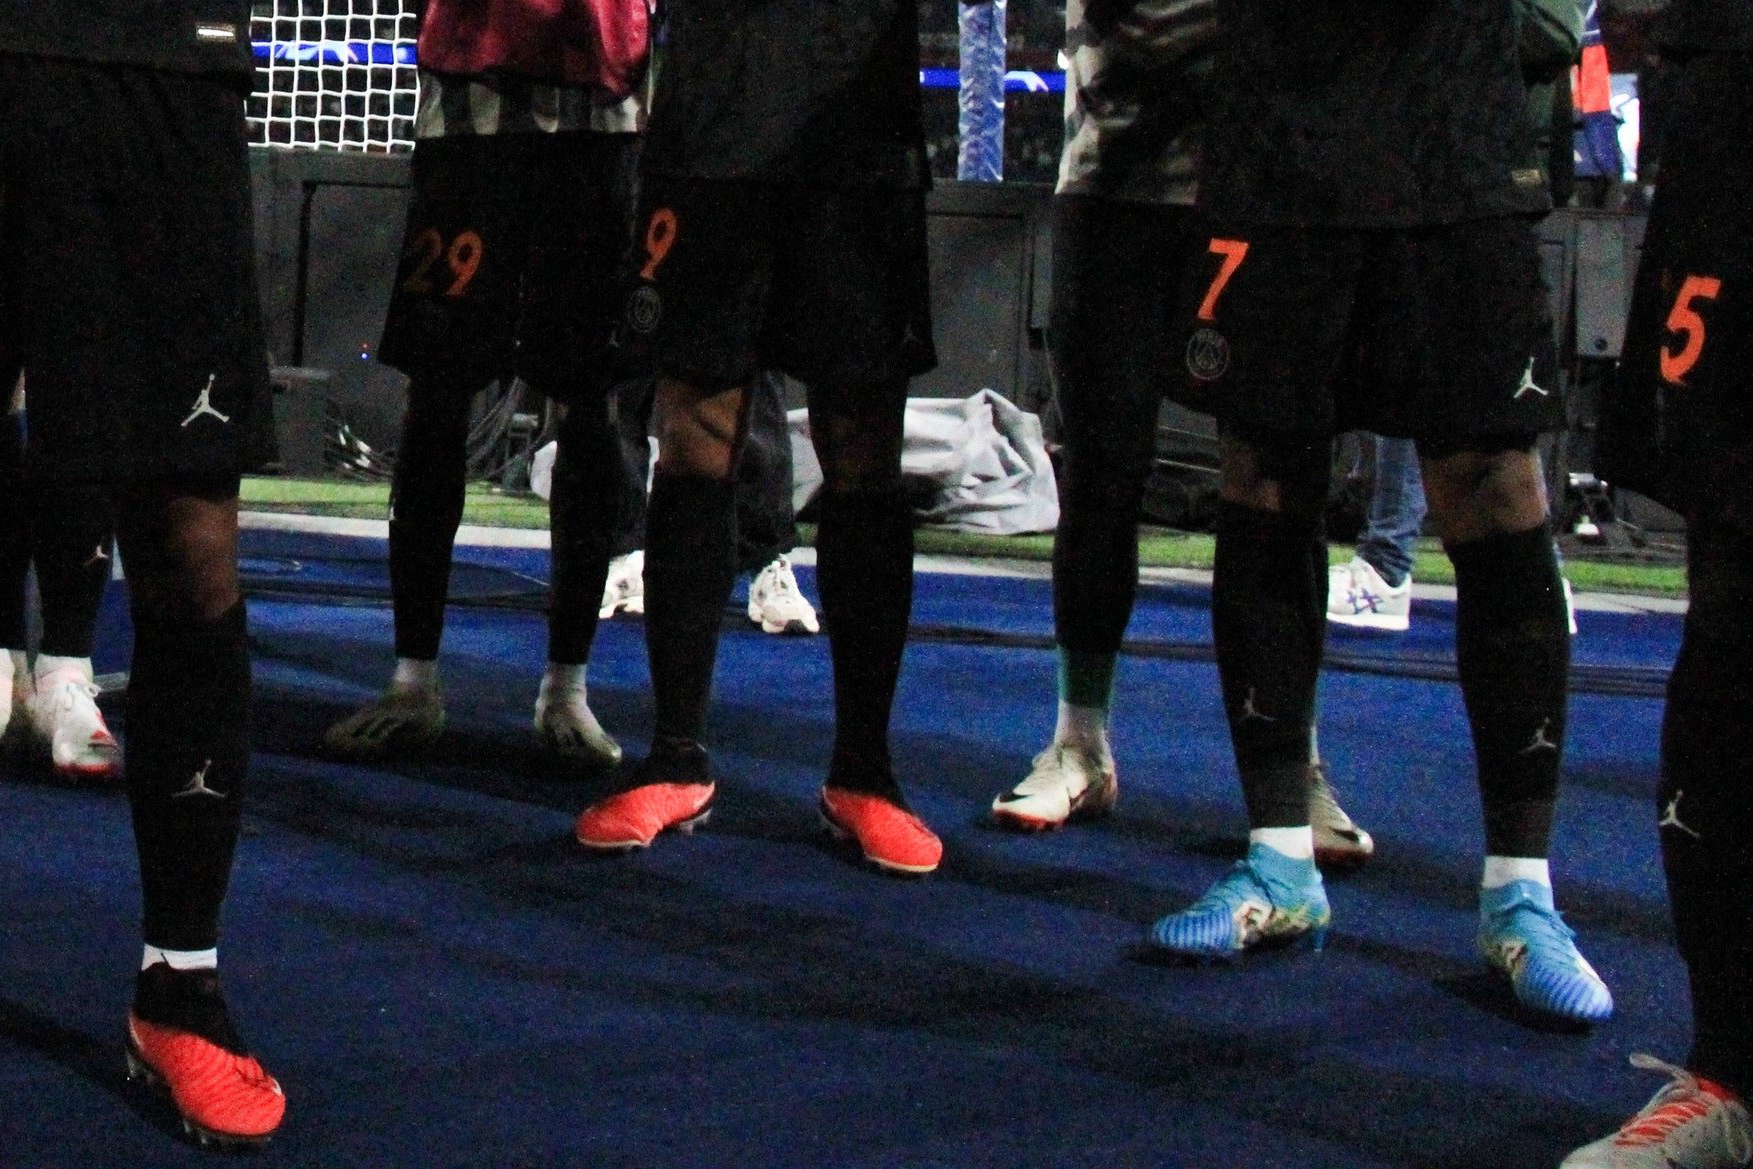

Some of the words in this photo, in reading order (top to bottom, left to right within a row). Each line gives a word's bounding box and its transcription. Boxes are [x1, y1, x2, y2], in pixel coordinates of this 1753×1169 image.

[403, 227, 486, 298] 29
[638, 206, 679, 280] 9
[1196, 236, 1250, 321] 7
[1659, 272, 1723, 385] 5
